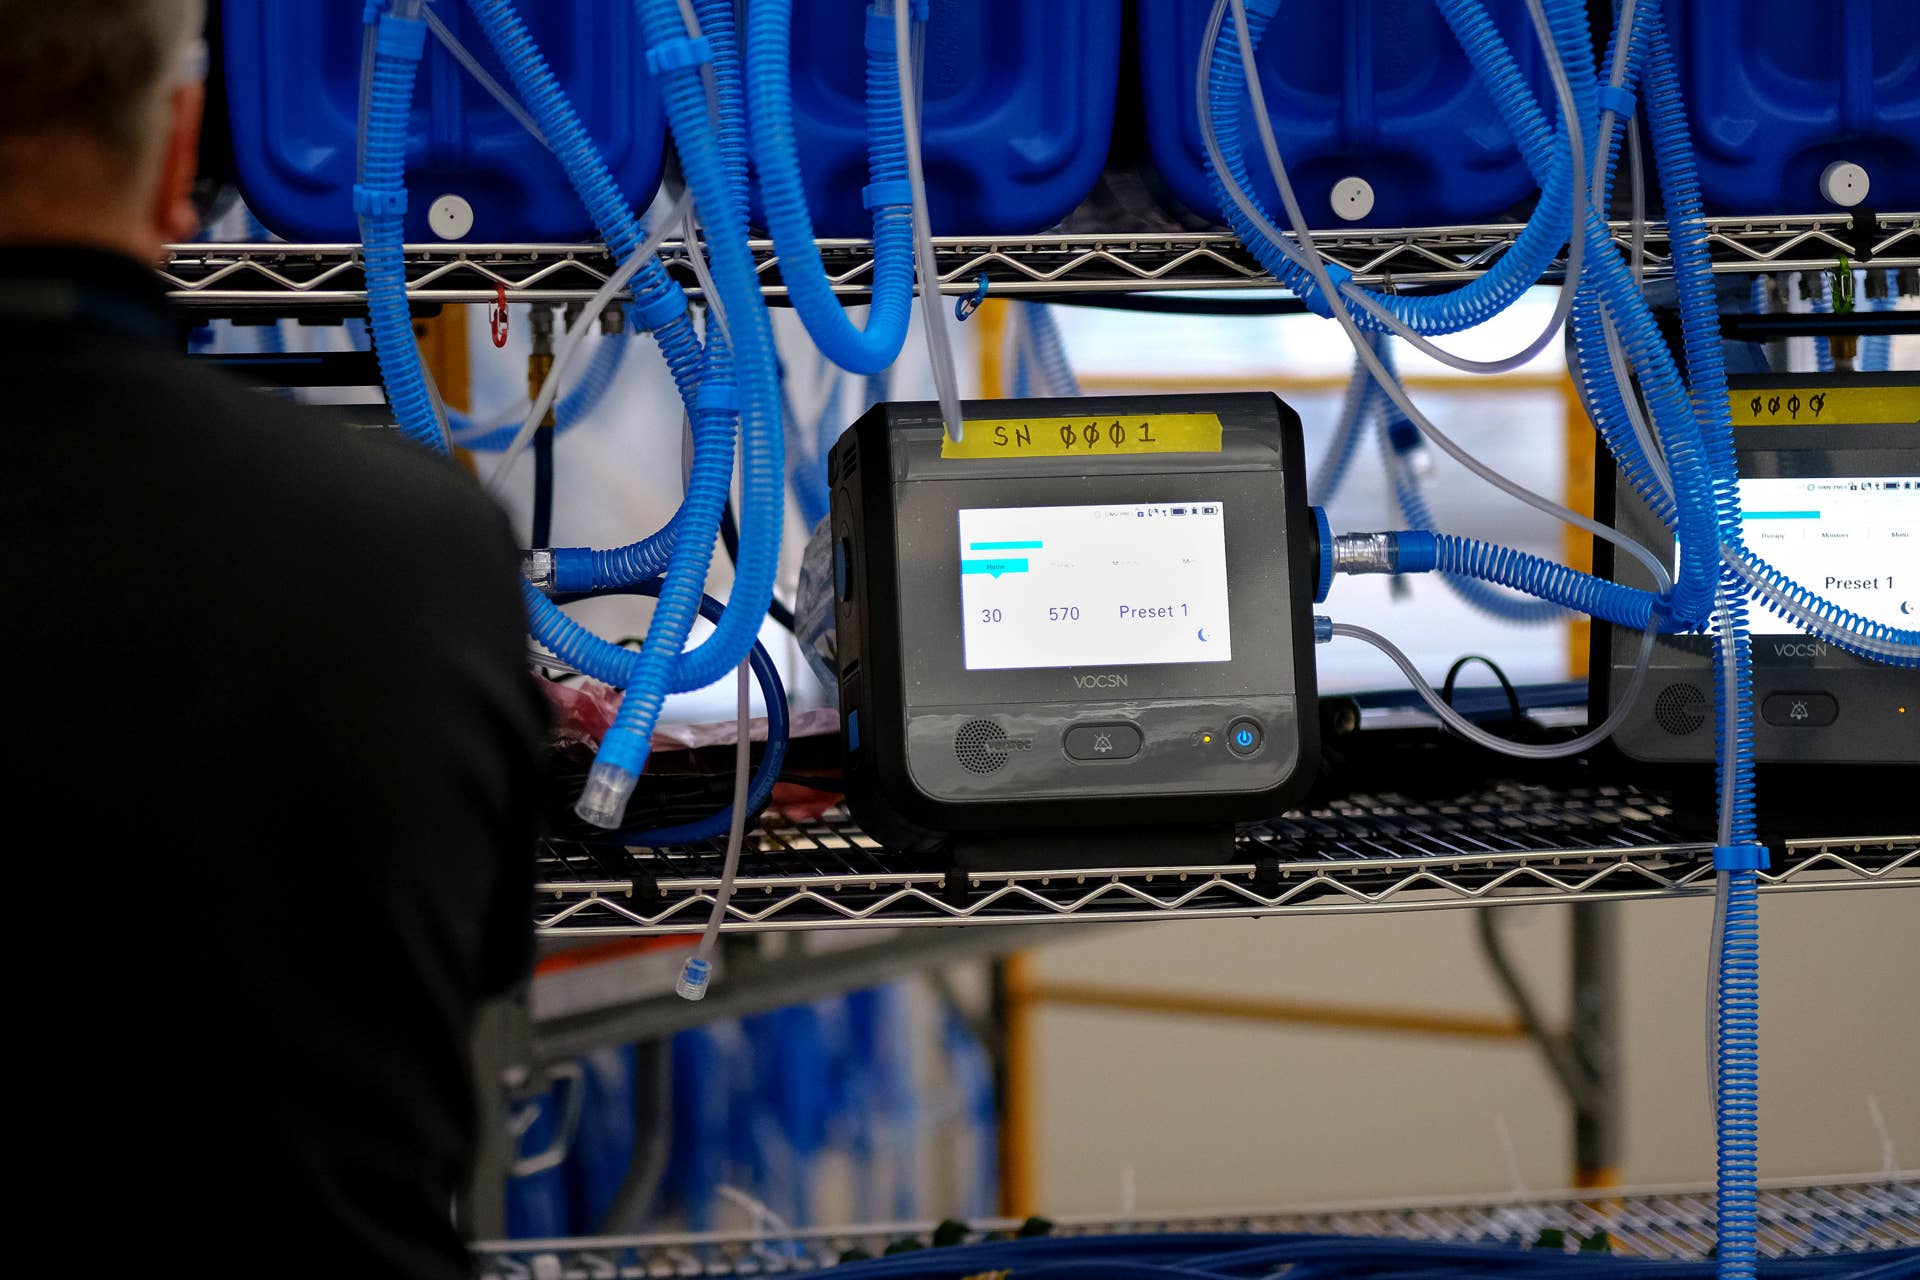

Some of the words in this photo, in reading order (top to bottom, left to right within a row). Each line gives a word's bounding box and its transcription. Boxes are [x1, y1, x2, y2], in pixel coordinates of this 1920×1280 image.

[993, 424, 1031, 447] SN
[1825, 576, 1879, 590] Preset
[1886, 576, 1894, 589] 1
[981, 608, 1002, 623] 30
[1049, 606, 1080, 622] 570
[1119, 604, 1174, 619] Preset
[1180, 603, 1189, 617] 1
[1773, 643, 1827, 657] VOCSN
[1073, 674, 1128, 689] VOCSN
